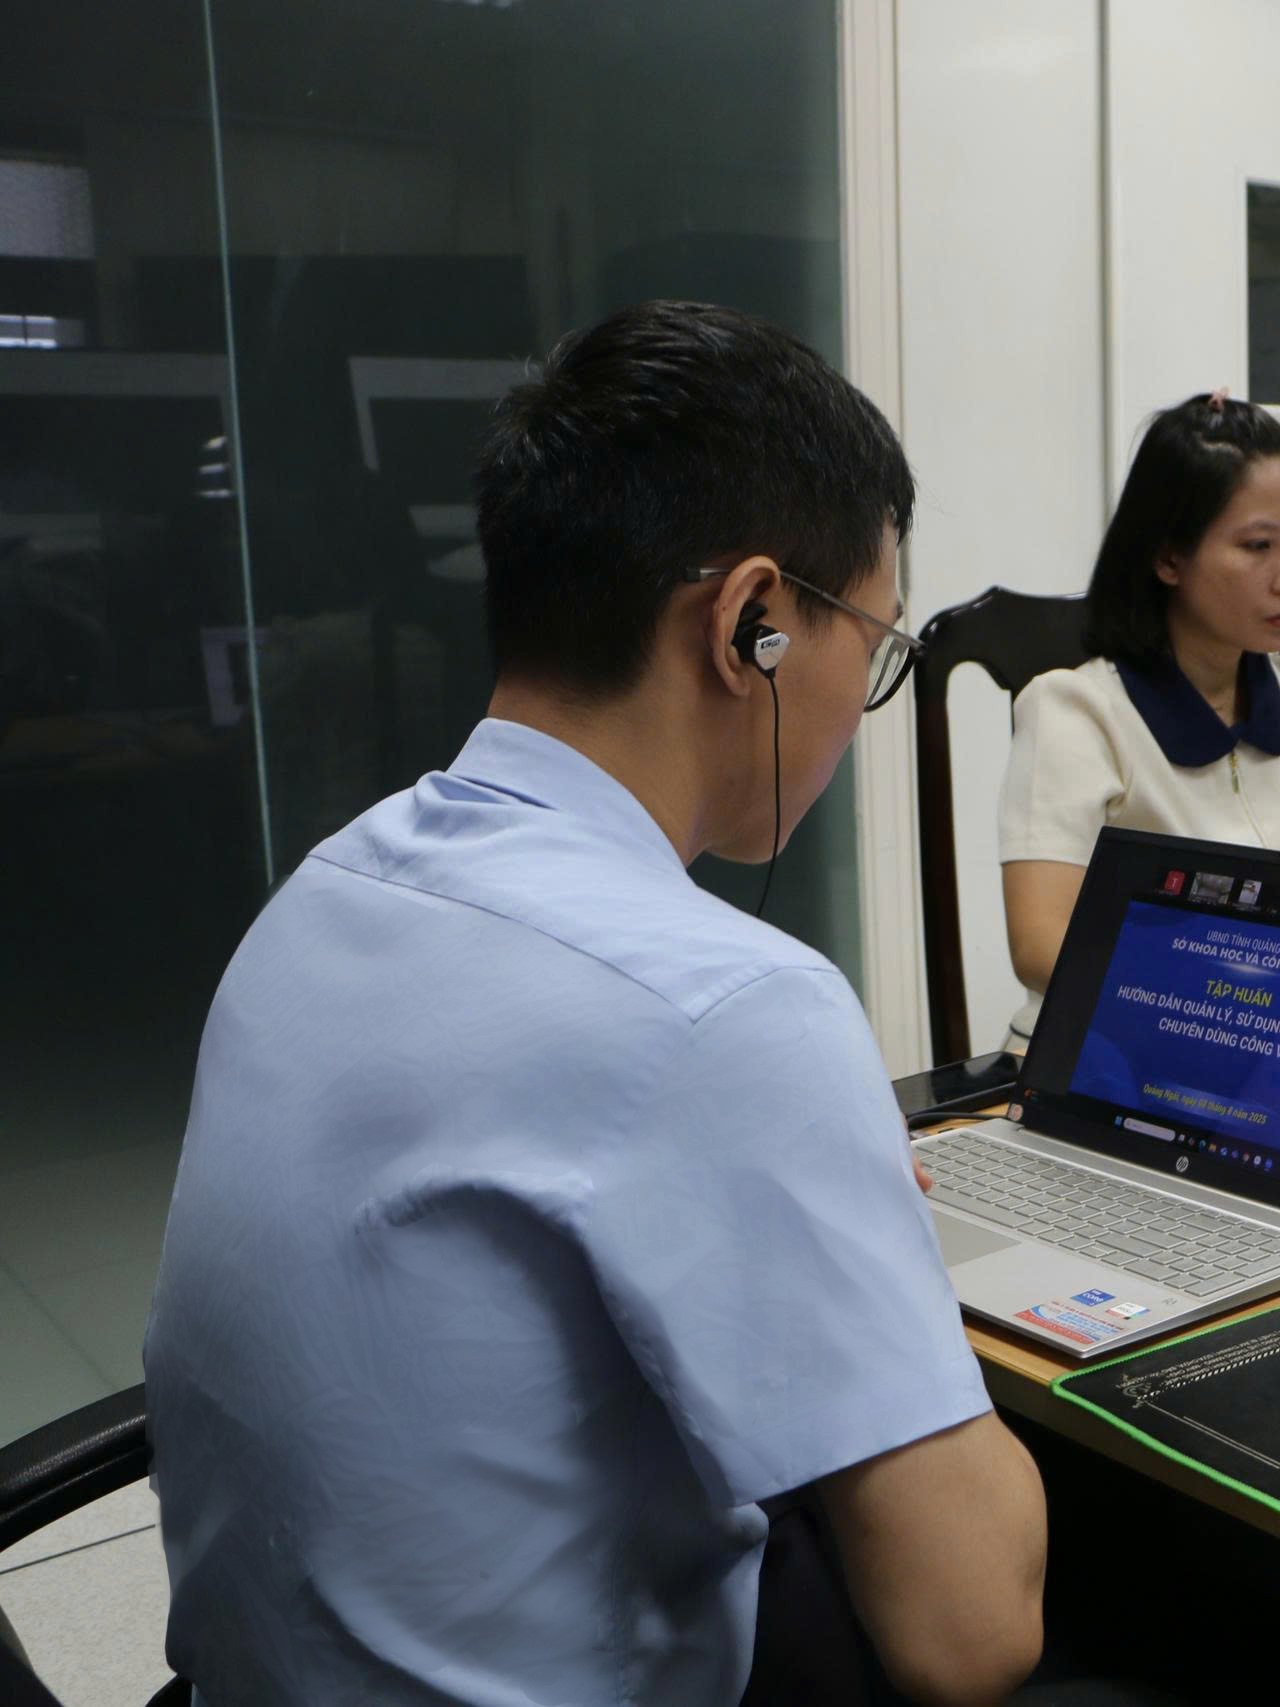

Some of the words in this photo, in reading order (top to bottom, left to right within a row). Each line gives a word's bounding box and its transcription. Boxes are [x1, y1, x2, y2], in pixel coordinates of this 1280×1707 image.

[1171, 936, 1187, 950] SỞ
[1188, 941, 1218, 957] KHOA
[1219, 947, 1244, 963] HỌC
[1245, 950, 1259, 965] VÀ
[1207, 930, 1230, 945] UBND
[1252, 938, 1280, 954] QUẢNG
[1117, 985, 1157, 1006] HƯỚNG
[1183, 1000, 1216, 1019] QUẢN
[1216, 1006, 1233, 1025] LÝ,
[1236, 1009, 1256, 1028] SỬ
[1206, 979, 1232, 999] TẬP
[1233, 986, 1273, 1008] HUẤN
[1158, 1017, 1205, 1040] CHUYÊN
[1205, 1026, 1239, 1047] DÙNG
[1240, 1035, 1274, 1056] CÔNG
[1248, 1111, 1268, 1125] 2025
